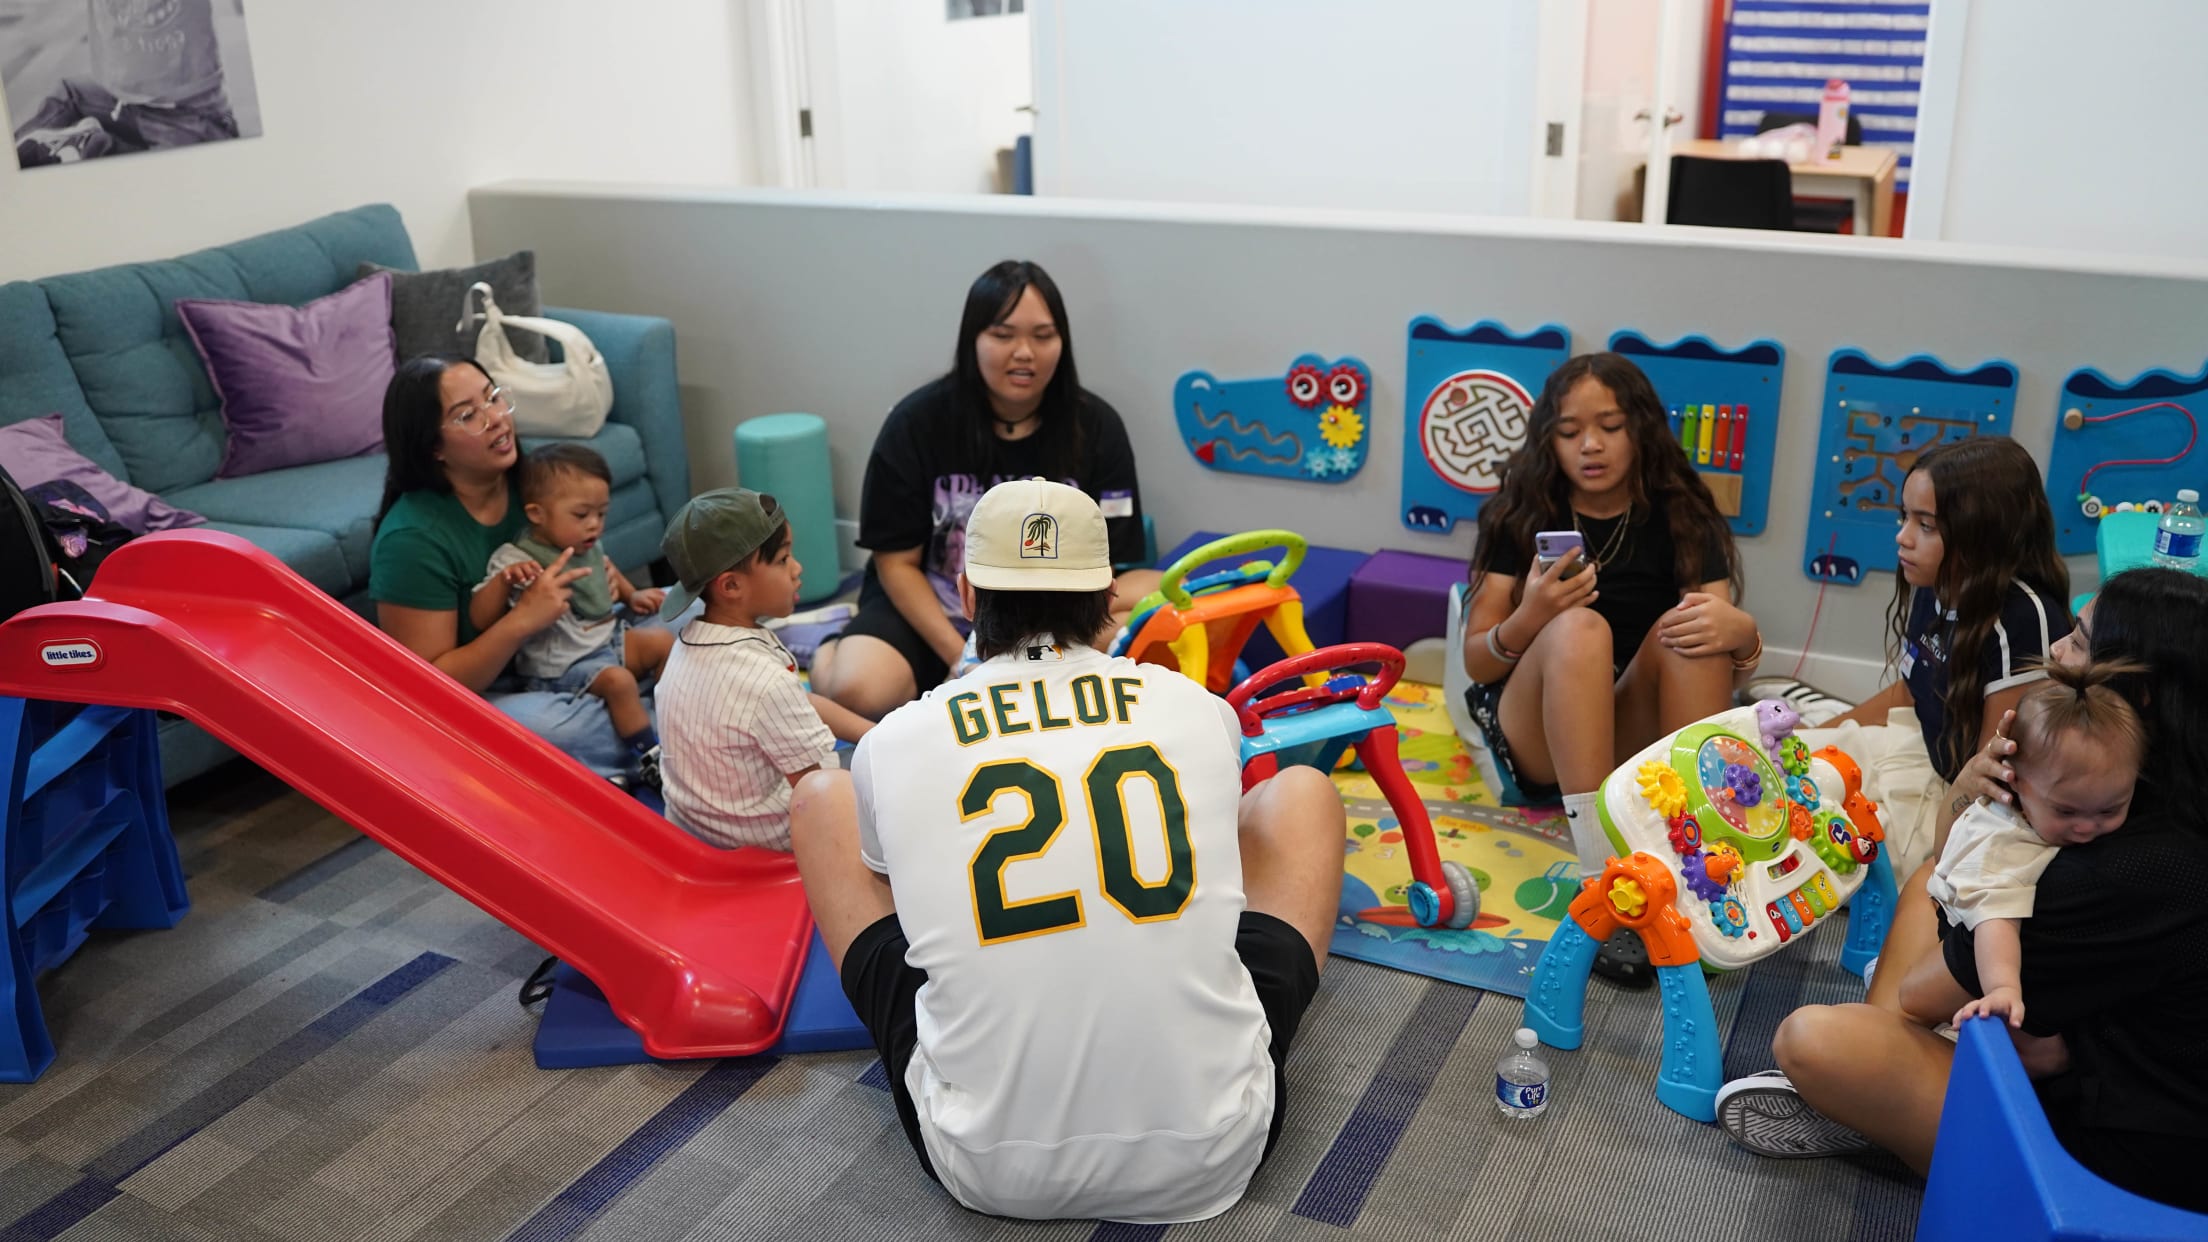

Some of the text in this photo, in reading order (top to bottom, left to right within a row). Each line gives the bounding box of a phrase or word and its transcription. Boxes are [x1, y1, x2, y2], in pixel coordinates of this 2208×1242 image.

[46, 650, 92, 660] little tikes
[946, 674, 1144, 747] GELOF
[956, 741, 1198, 947] 20
[1527, 1092, 1540, 1101] Life
